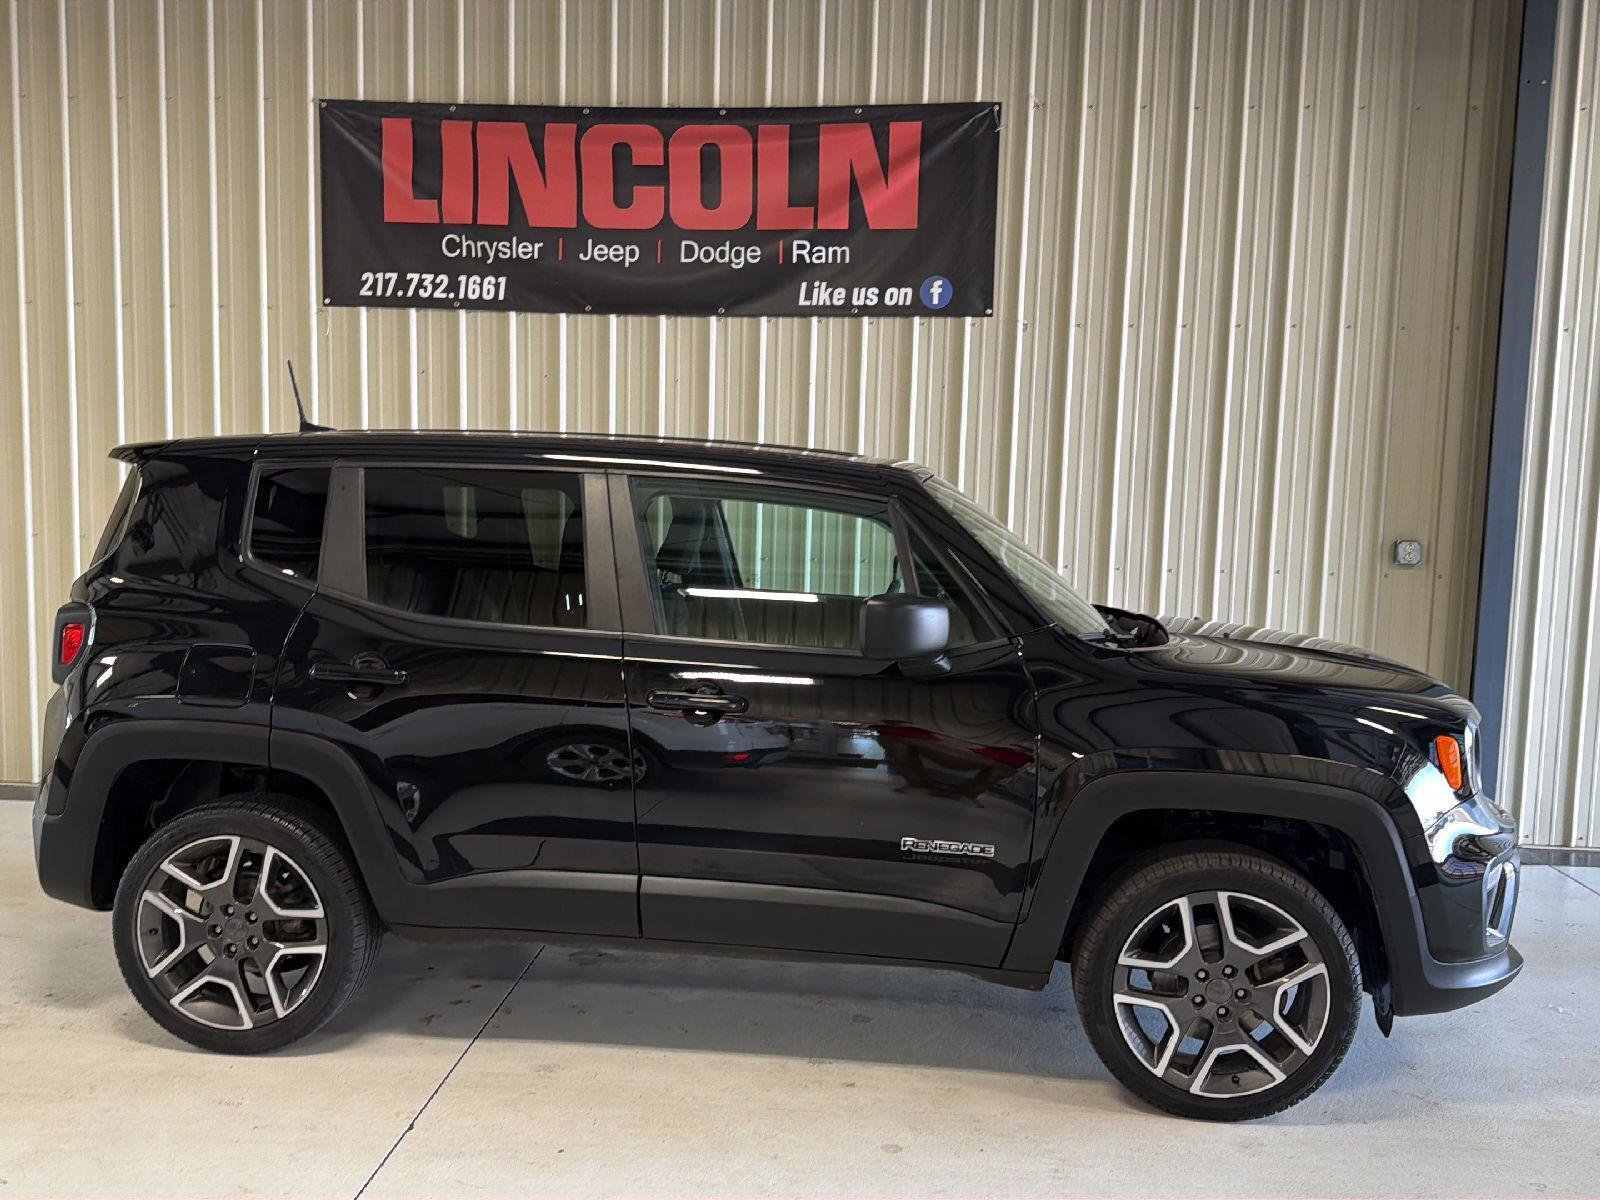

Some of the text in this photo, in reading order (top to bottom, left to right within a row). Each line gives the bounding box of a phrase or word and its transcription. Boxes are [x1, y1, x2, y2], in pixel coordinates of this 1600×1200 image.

[382, 117, 923, 230] LINCOLN
[441, 234, 851, 268] Chrysler Jeep Dodge Ram
[359, 271, 508, 301] 217.732.1661
[798, 281, 848, 307] Like
[851, 288, 879, 307] us
[884, 288, 913, 307] on
[900, 837, 995, 857] RENEGADE
